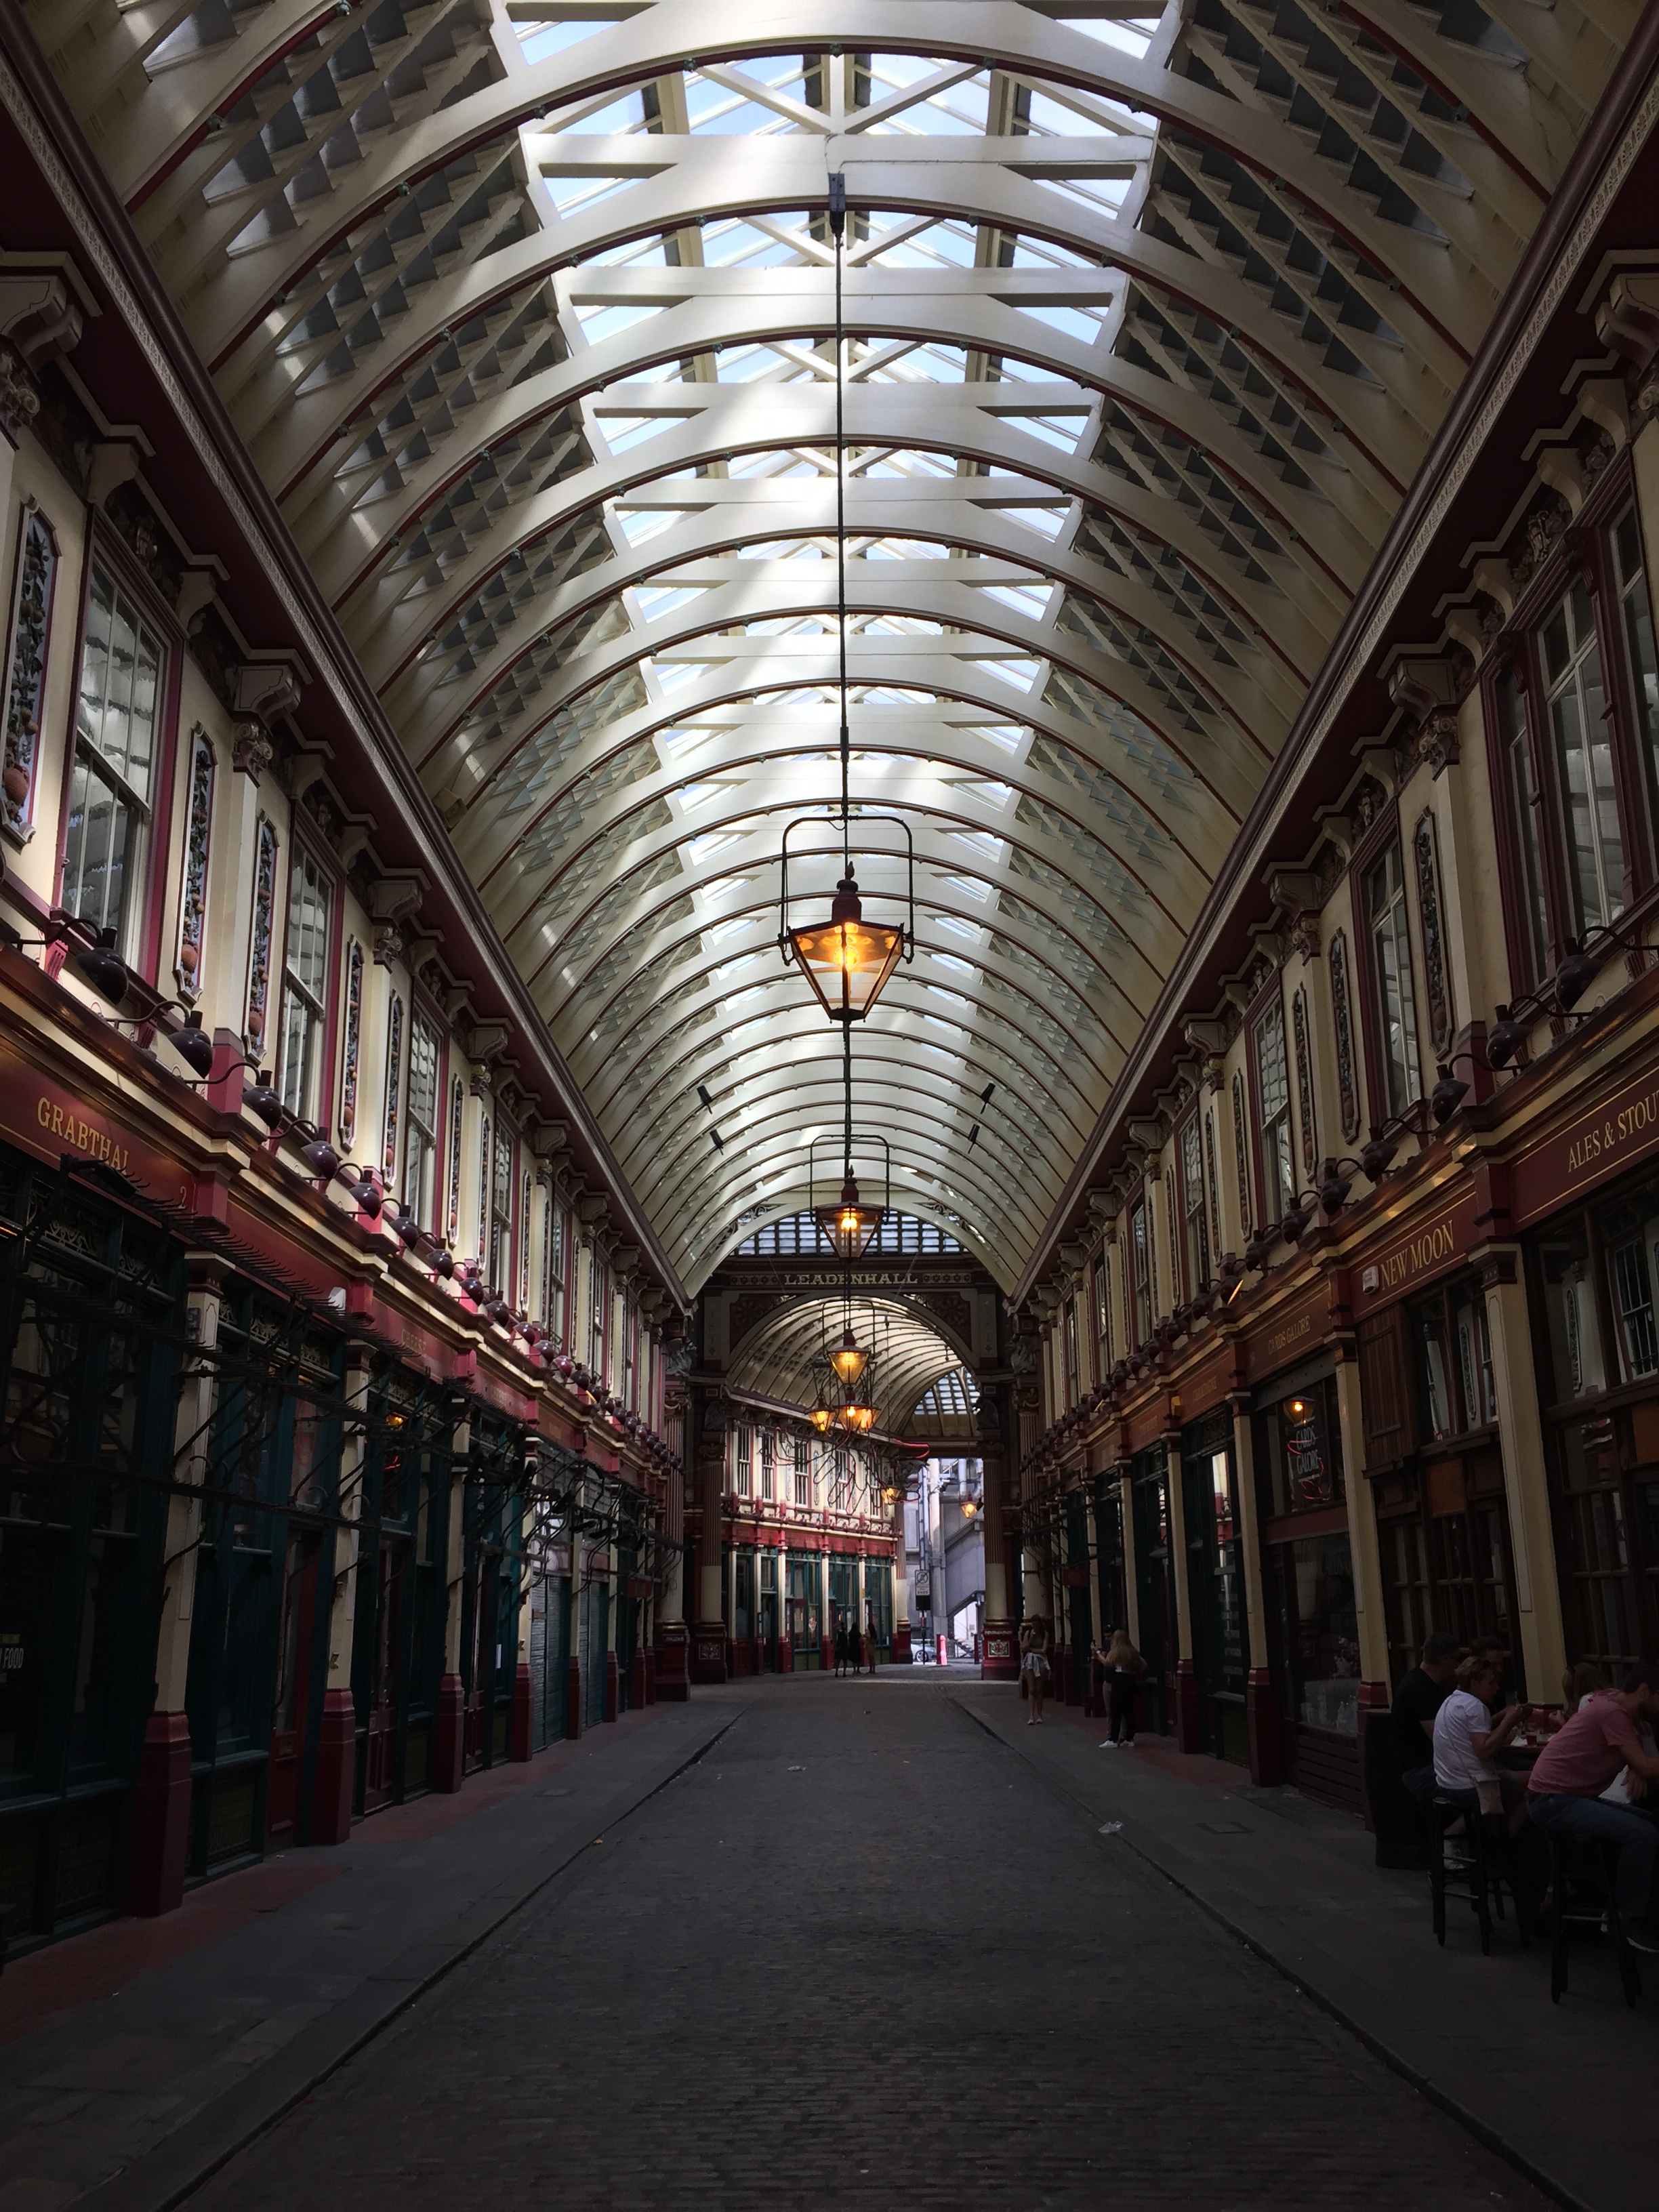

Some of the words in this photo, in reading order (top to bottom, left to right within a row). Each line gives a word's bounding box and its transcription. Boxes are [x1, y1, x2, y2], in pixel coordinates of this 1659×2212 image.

[1568, 1129, 1601, 1173] ALES
[1604, 1121, 1616, 1149] &
[1618, 1090, 1659, 1141] STOU
[179, 1186, 187, 1209] 2
[1380, 1248, 1408, 1291] NEW
[1410, 1219, 1454, 1273] MOON
[784, 1273, 918, 1285] LEADENHALL
[1268, 1330, 1286, 1355] CARDS
[1287, 1315, 1311, 1344] GALORE
[1296, 1425, 1315, 1450] CARDS
[3, 1647, 24, 1669] FOOD
